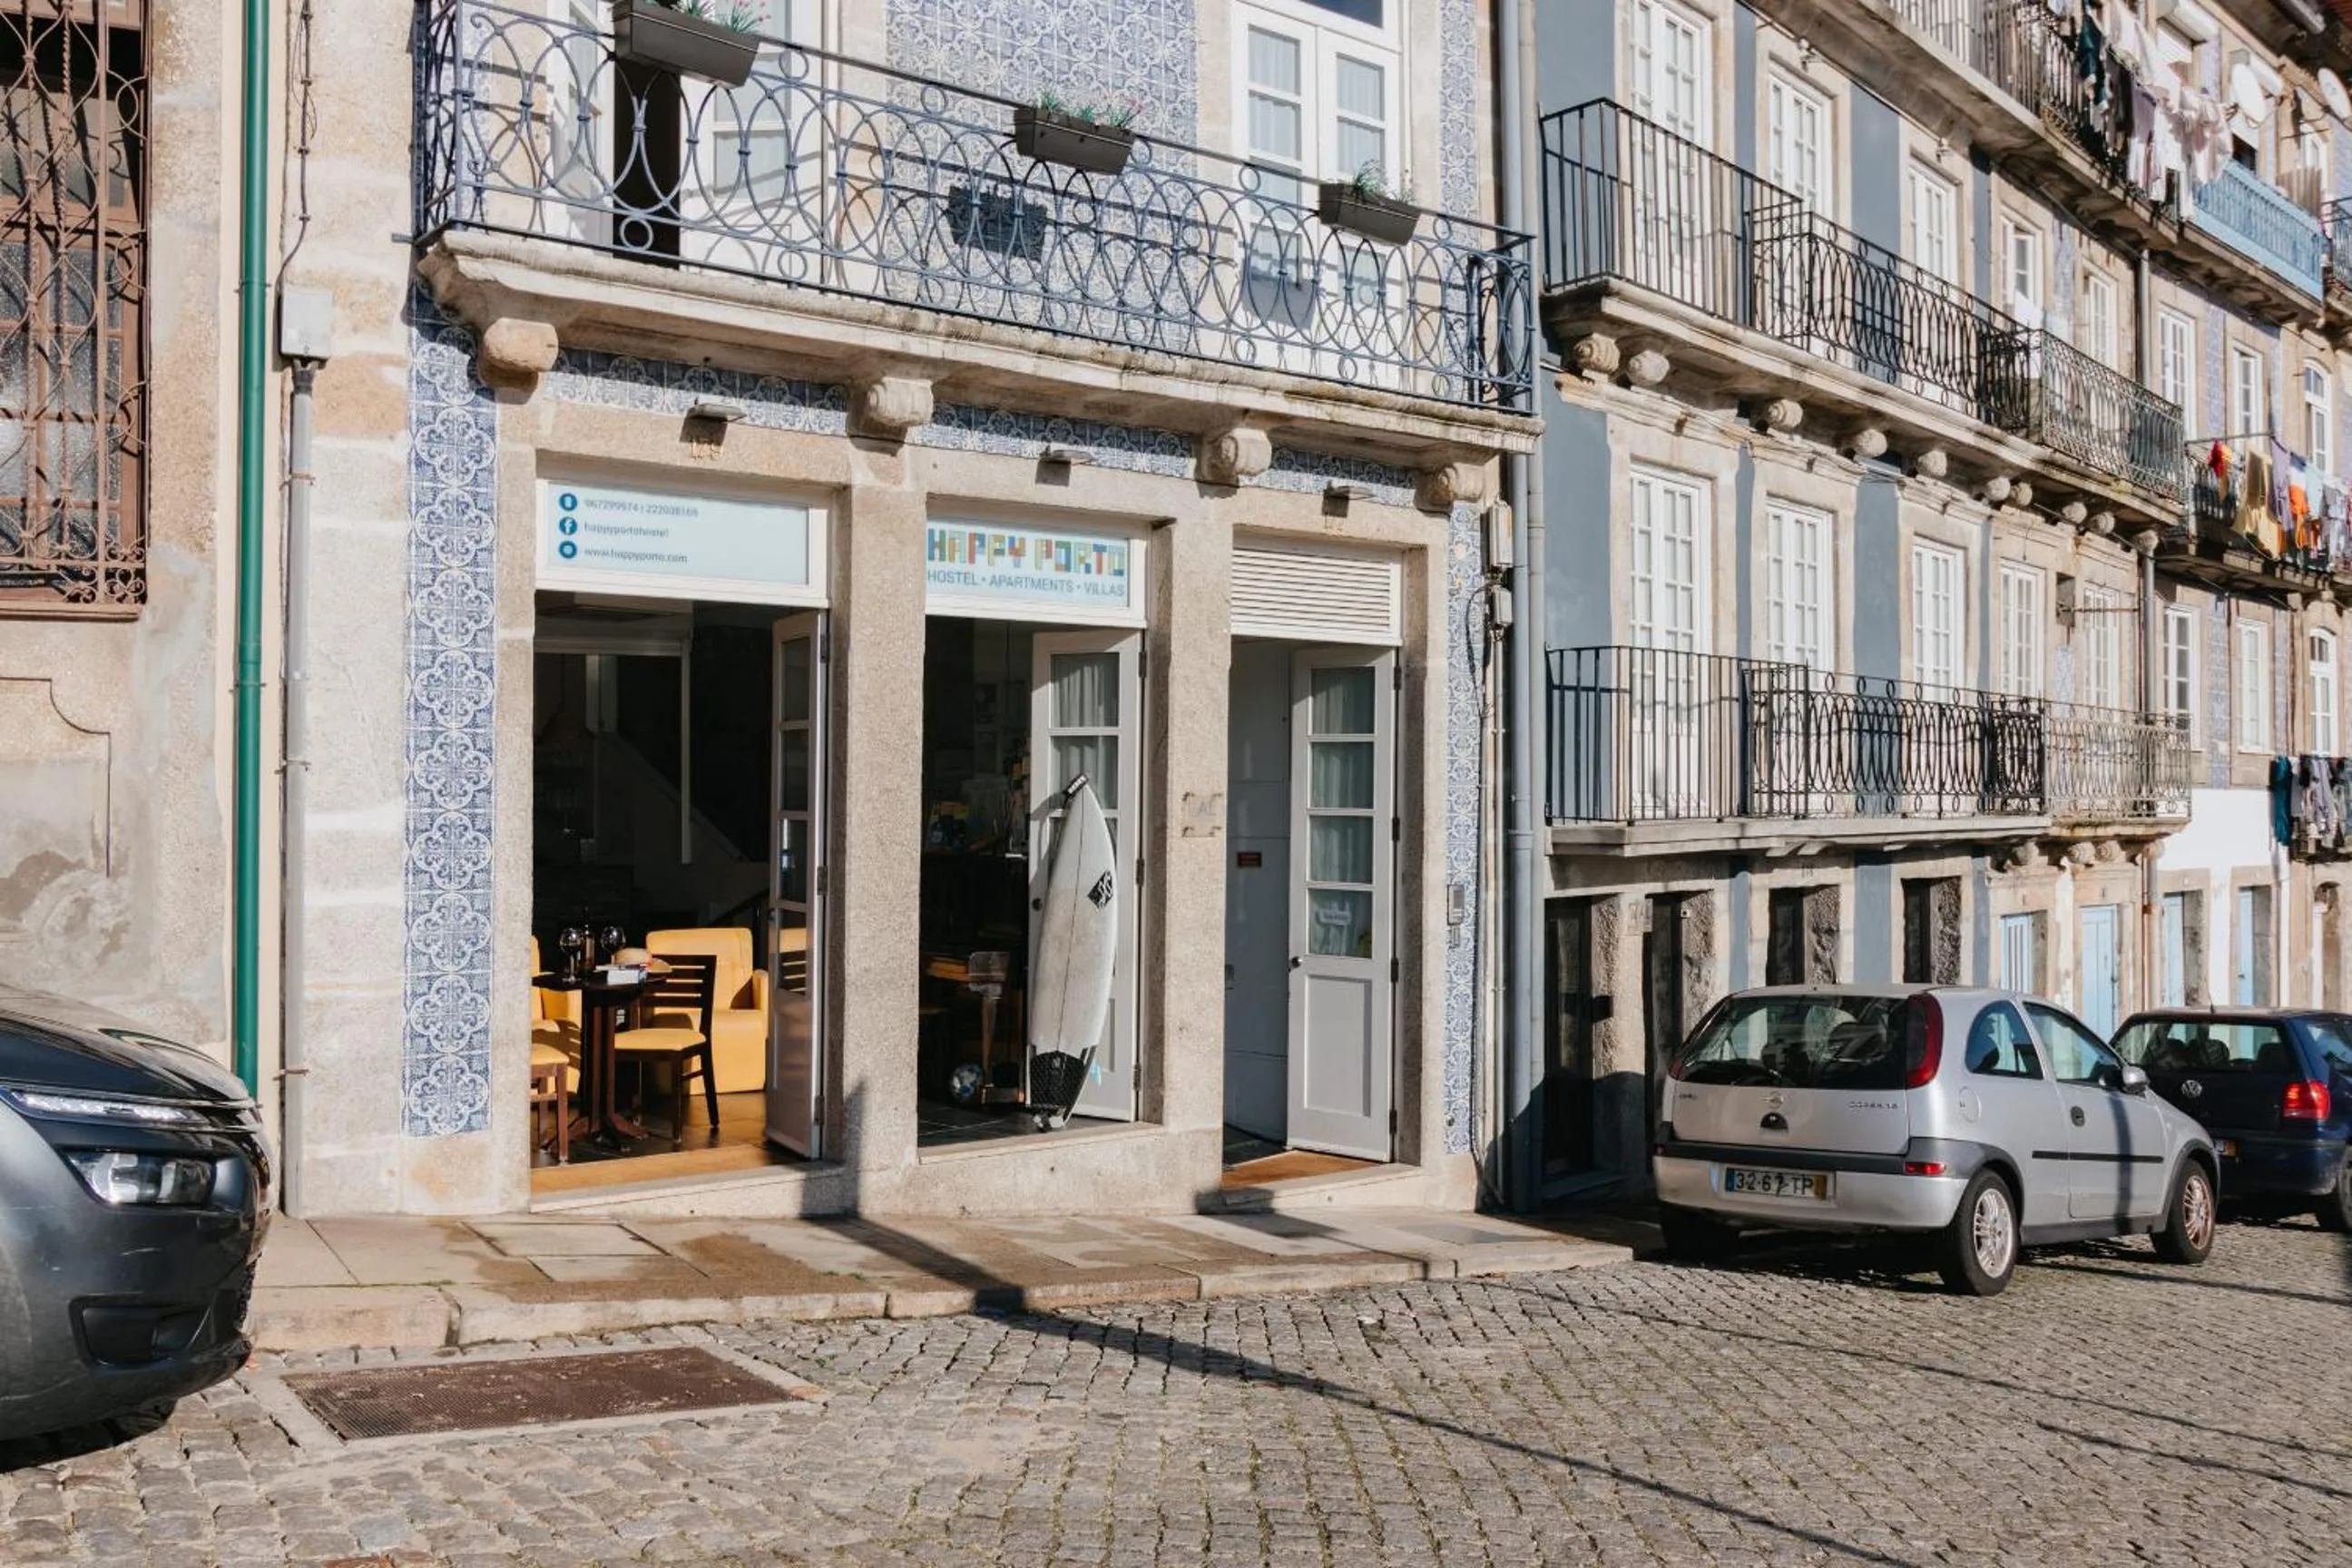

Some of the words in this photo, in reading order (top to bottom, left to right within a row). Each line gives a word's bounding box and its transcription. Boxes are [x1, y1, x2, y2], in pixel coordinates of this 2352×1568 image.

[927, 528, 1026, 568] HAPPY
[1034, 538, 1125, 577] PORTO
[927, 570, 978, 586] HOSTEL
[989, 574, 1074, 593] APARTMENTS
[1083, 582, 1125, 597] VILLAS
